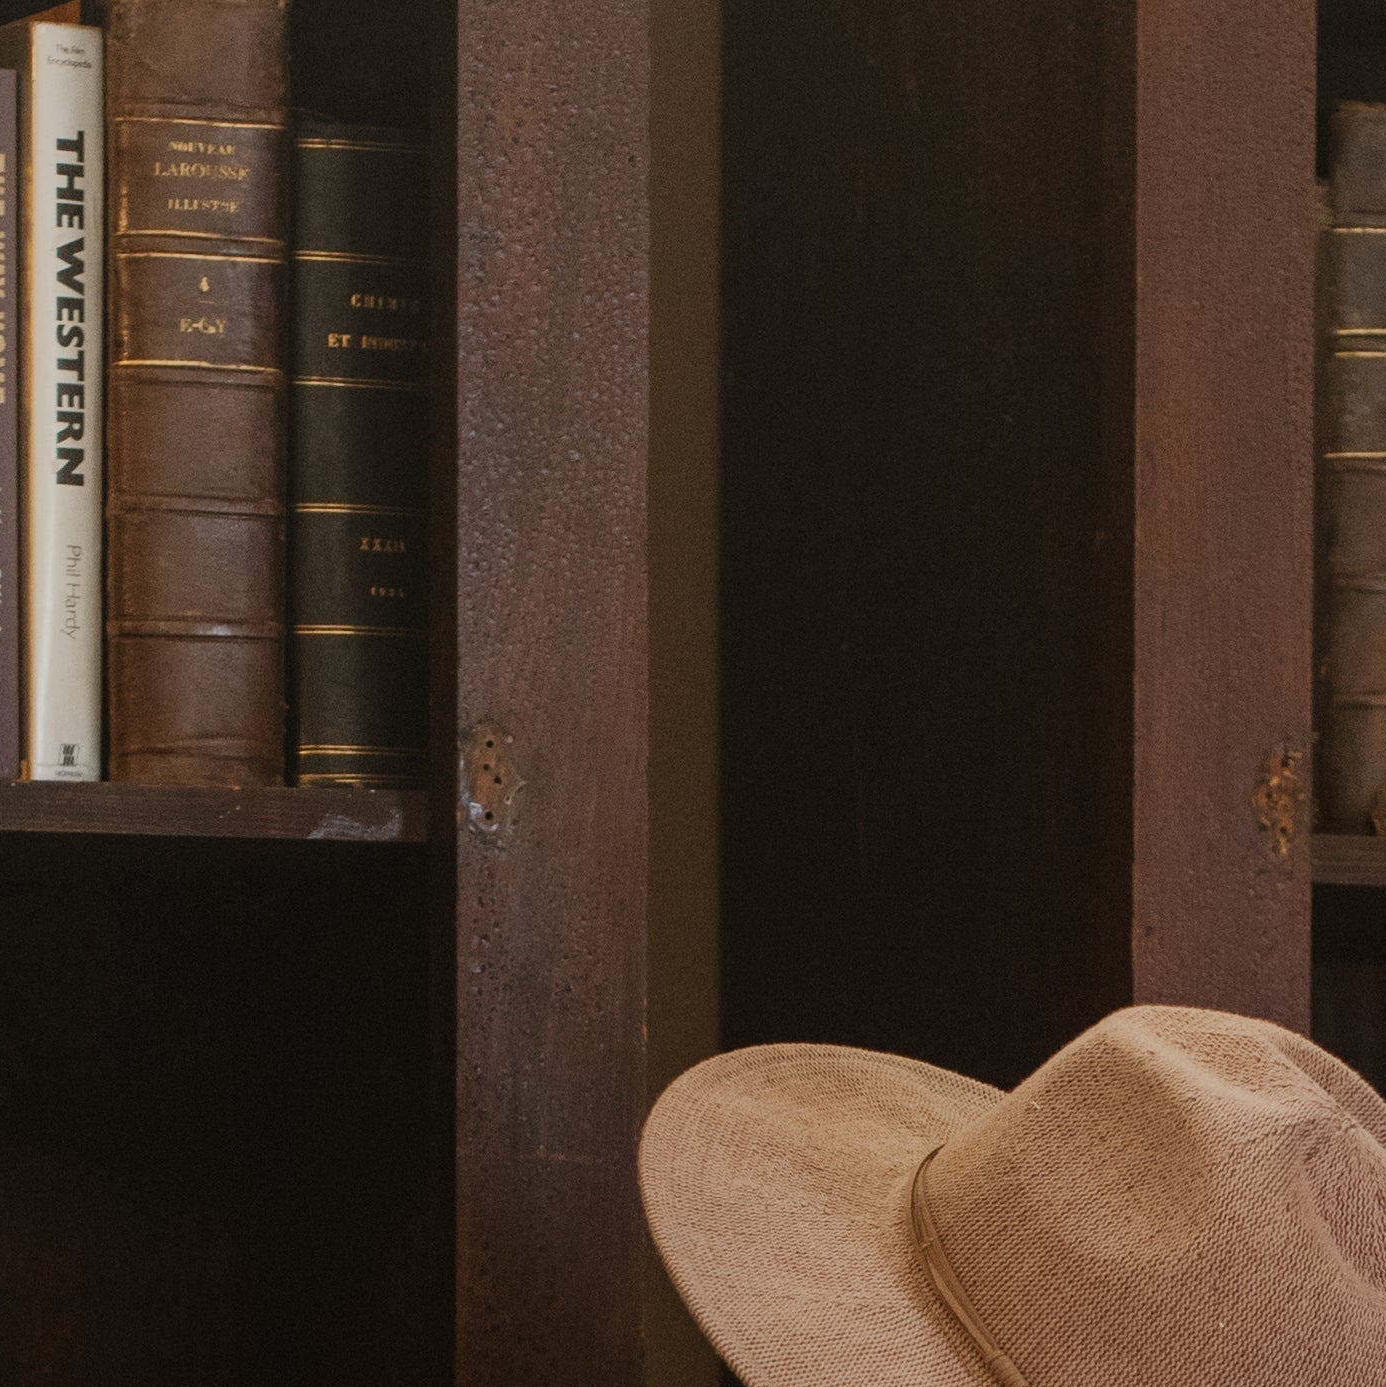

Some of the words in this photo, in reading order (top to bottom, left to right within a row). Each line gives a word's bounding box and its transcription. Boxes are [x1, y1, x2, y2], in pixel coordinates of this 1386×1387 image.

[56, 130, 85, 230] THE
[154, 162, 251, 181] LAROUSSE
[56, 237, 85, 487] WESTERN
[66, 545, 82, 577] Phil
[61, 583, 81, 640] Hardy
